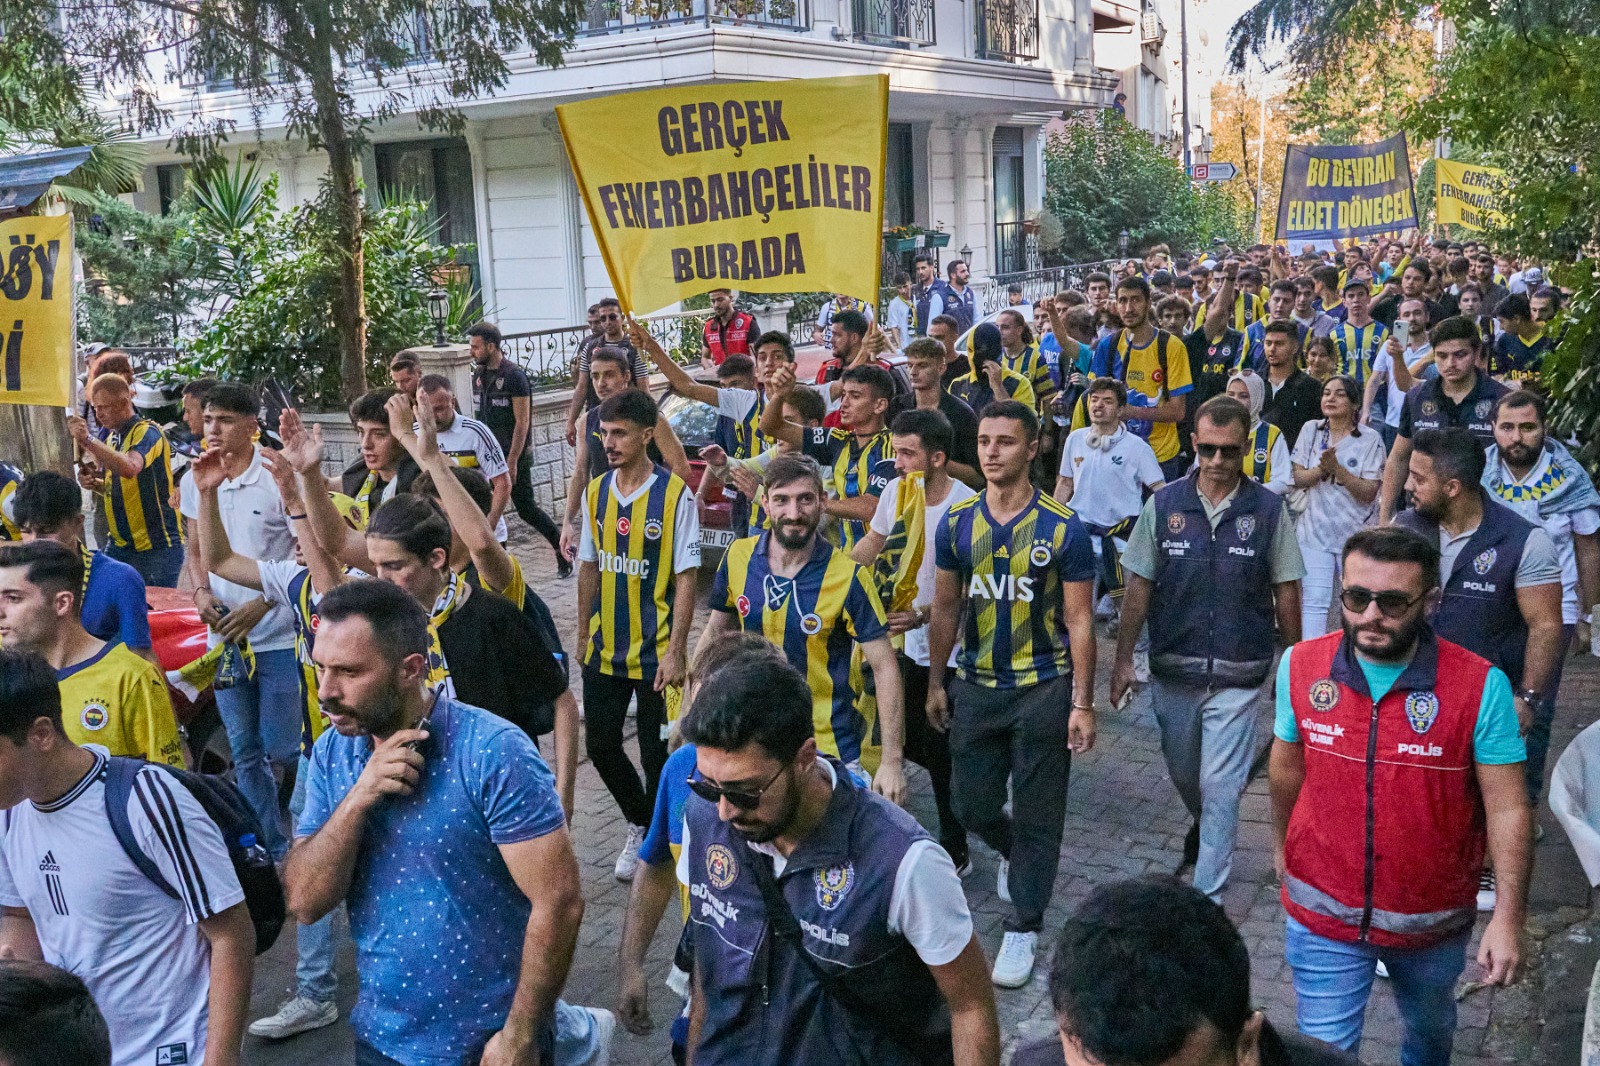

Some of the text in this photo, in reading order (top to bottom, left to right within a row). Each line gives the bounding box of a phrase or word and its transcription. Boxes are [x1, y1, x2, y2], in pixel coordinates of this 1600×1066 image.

[658, 100, 790, 157] GERÇEK
[1306, 151, 1396, 188] BU DEVRAN
[598, 154, 871, 229] FENERBAHÇELİLER
[1286, 188, 1413, 231] ELBET DÖNECEK
[0, 234, 60, 301] ÖY
[671, 232, 805, 284] BURADA
[1346, 348, 1372, 361] AVIS
[598, 549, 650, 579] Otokoç
[1228, 546, 1255, 557] POLİS
[968, 573, 1035, 603] AVIS
[1463, 581, 1496, 592] POLİS
[1397, 742, 1444, 757] POLİS
[39, 864, 60, 872] adidas
[800, 918, 850, 947] POLİS
